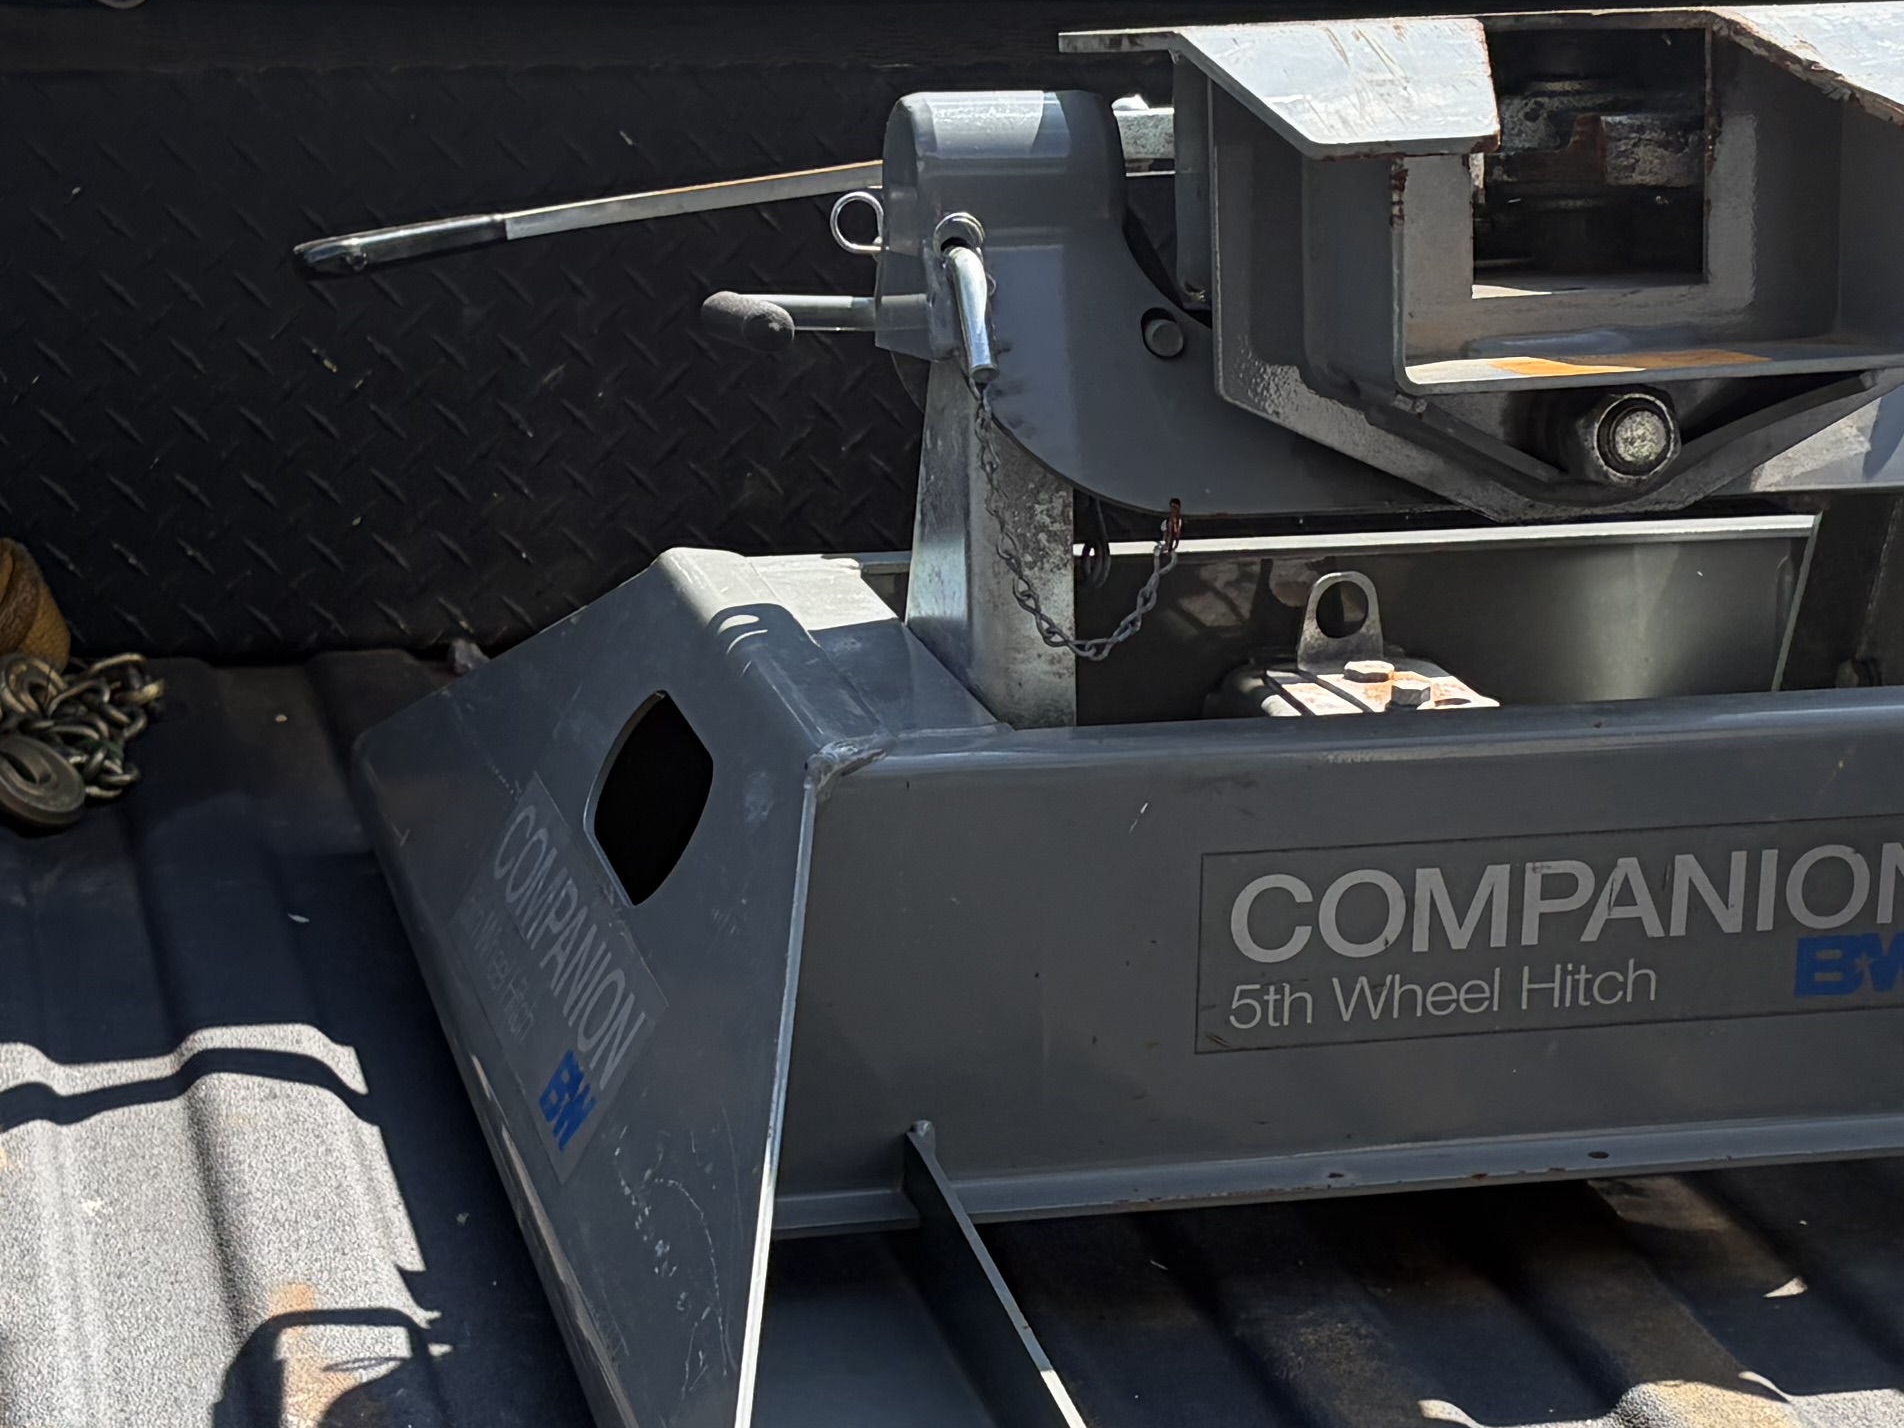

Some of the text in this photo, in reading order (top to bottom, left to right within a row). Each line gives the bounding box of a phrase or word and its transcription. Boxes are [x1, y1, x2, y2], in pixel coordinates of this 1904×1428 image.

[496, 805, 647, 1090] COMPANION
[1229, 958, 1657, 1029] 5th Wheel Hitch
